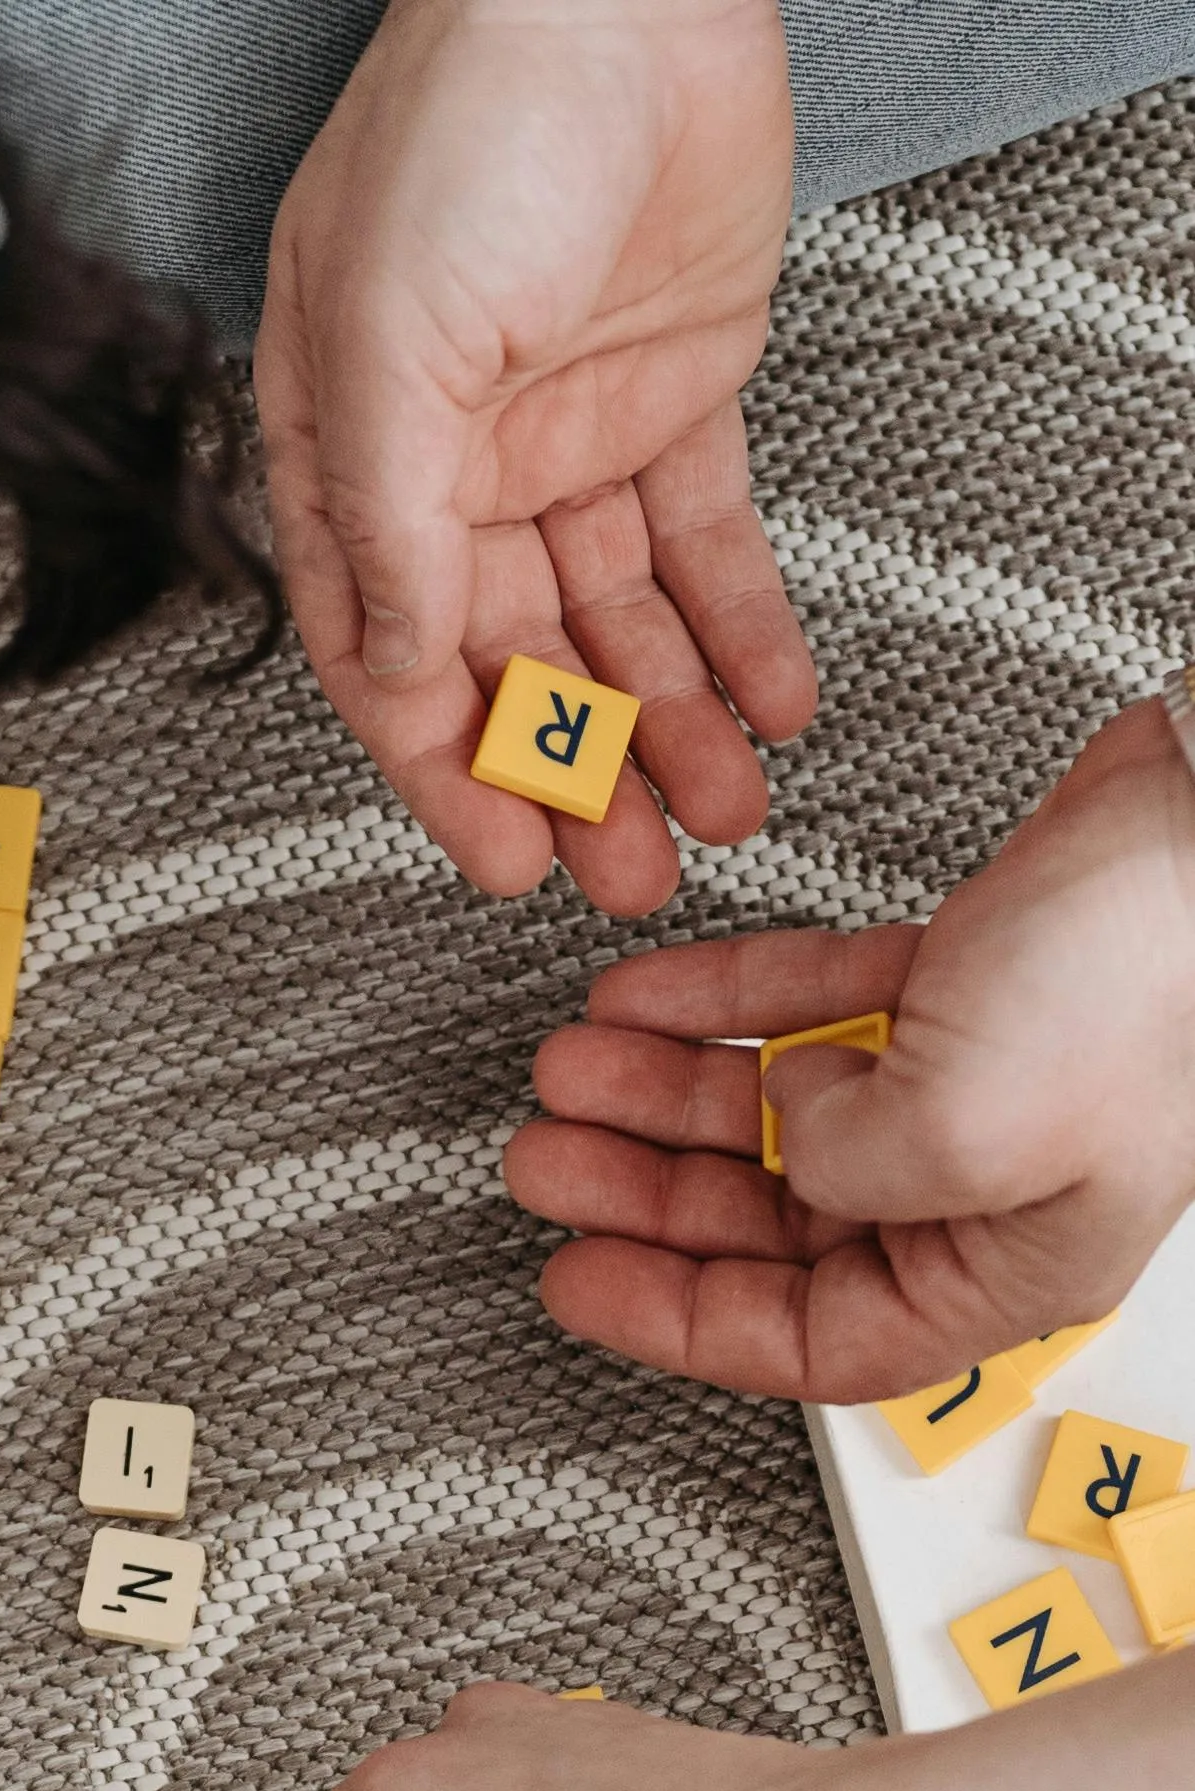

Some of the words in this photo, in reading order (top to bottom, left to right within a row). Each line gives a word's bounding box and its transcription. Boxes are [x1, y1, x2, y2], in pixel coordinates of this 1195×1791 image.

[535, 691, 591, 766] R
[1085, 1445, 1141, 1519] R
[990, 1608, 1080, 1693] N
